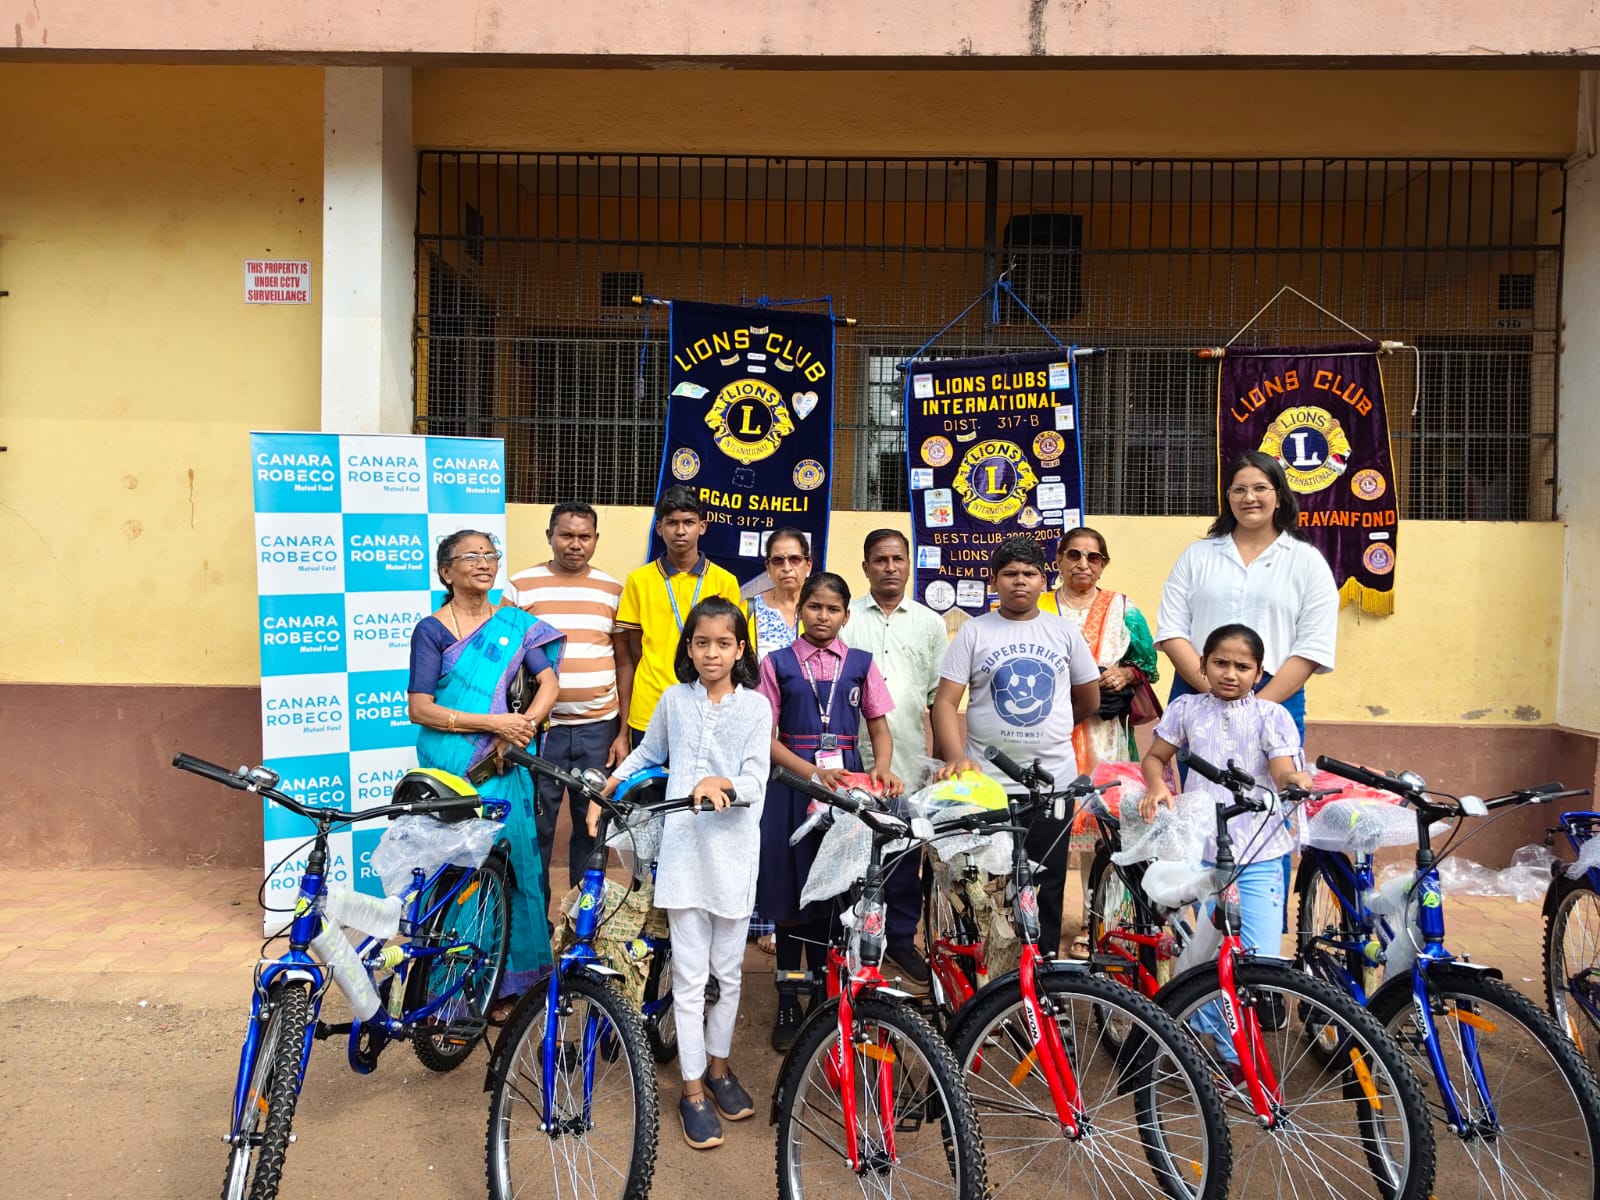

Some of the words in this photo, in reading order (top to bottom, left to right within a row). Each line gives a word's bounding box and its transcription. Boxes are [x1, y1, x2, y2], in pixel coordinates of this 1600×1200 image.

[246, 262, 263, 274] THIS
[264, 262, 300, 274] PROPERTY
[300, 263, 308, 274] IS
[254, 276, 278, 288] UNDER
[280, 276, 300, 288] CCTV
[248, 290, 306, 302] SURVEILLANCE
[674, 329, 750, 372] LIONS
[766, 333, 826, 382] CLUB
[935, 375, 986, 396] LIONS
[992, 371, 1047, 392] CLUBS
[726, 384, 776, 403] LIONS
[1231, 370, 1300, 422] LIONS
[1313, 370, 1374, 416] CLUB
[923, 392, 1062, 416] INTERNATIONAL
[739, 406, 762, 434] L
[944, 418, 981, 432] DIST.
[998, 415, 1040, 428] 317-B
[1280, 412, 1326, 428] LIONS
[970, 444, 1018, 461] LIONS
[1290, 432, 1322, 466] L
[257, 453, 333, 467] CANARA
[348, 455, 418, 468] CANARA
[432, 458, 500, 470] CANARA
[257, 469, 335, 482] ROBECO
[348, 471, 420, 484] ROBECO
[433, 472, 502, 485] ROBECO
[985, 466, 1007, 494] L
[1286, 470, 1335, 486] TERNATIONA
[294, 484, 316, 492] Mutual
[318, 484, 333, 492] Fund
[695, 486, 742, 508] RGAO
[749, 495, 808, 512] SAHELI
[706, 510, 732, 526] DIST.
[737, 516, 774, 528] 317-B
[1298, 510, 1395, 528] RAVANFOND
[261, 535, 335, 548] CANARA
[350, 534, 422, 546] CANARA
[934, 532, 968, 544] BEST
[261, 551, 337, 563] ROBECO
[351, 549, 424, 562] ROBECO
[950, 550, 988, 561] LIONS
[322, 564, 336, 572] Fund
[939, 565, 974, 577] ALEM
[264, 615, 338, 629] CANARA
[354, 612, 422, 625] CANARA
[264, 630, 340, 645] ROBECO
[354, 628, 412, 640] ROBEC
[324, 644, 338, 652] Fund
[982, 643, 1066, 674] SUPERSTRIKER
[266, 696, 340, 711] CANARA
[356, 690, 408, 704] CANA
[266, 710, 342, 726] ROBECO
[356, 705, 409, 720] ROBE
[326, 724, 342, 732] Fund
[278, 775, 343, 792] ANARA
[358, 769, 404, 784] CANA
[269, 790, 345, 808] RBECO
[359, 786, 392, 799] ROB
[271, 856, 344, 874] CANA
[1224, 996, 1236, 1030] AVON
[1416, 1002, 1427, 1034] AVON
[1026, 1006, 1038, 1039] AVON
